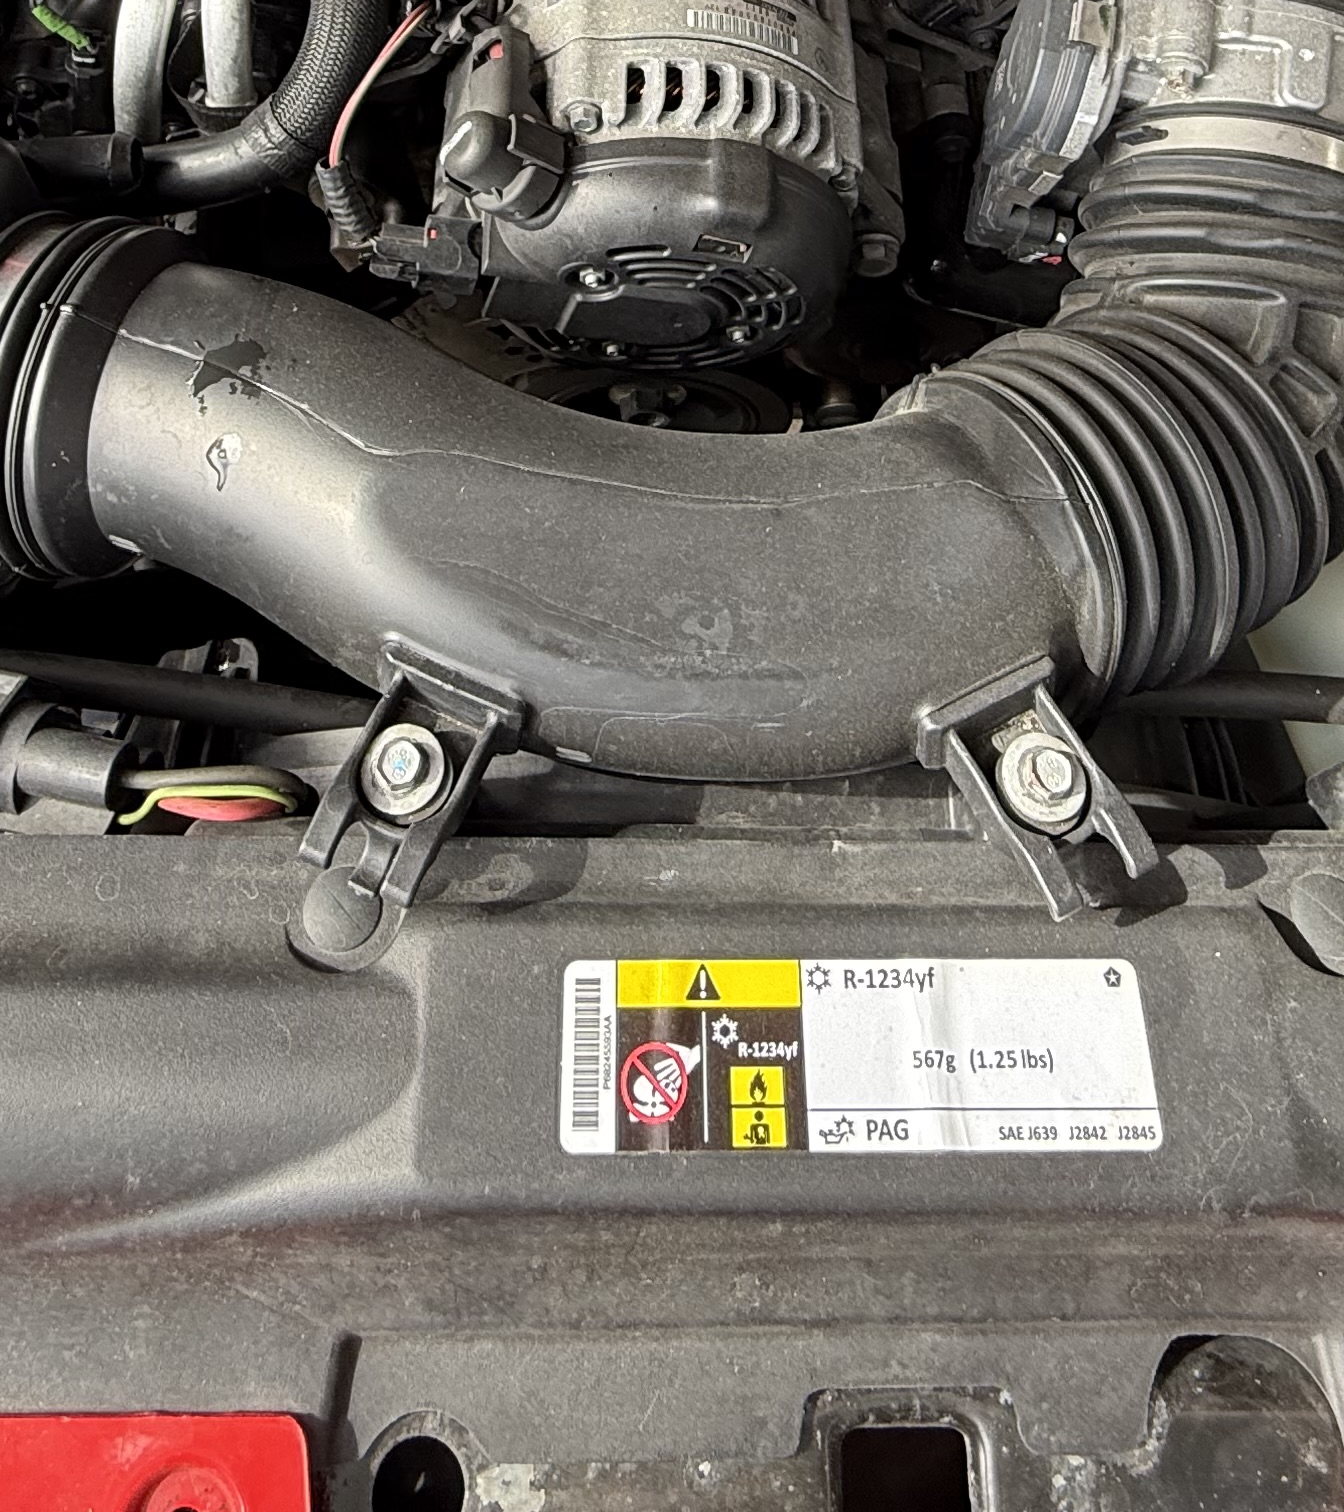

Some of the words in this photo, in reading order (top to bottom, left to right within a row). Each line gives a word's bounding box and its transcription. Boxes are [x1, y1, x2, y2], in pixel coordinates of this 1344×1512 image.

[843, 966, 936, 993] R-1234yf
[737, 1040, 799, 1062] R-1234yf
[912, 1049, 957, 1073] 567g
[969, 1048, 1018, 1074] (1.25
[1021, 1048, 1055, 1074] lbs)
[866, 1119, 910, 1140] PAG
[998, 1126, 1025, 1141] SAE
[1027, 1126, 1058, 1140] J639
[1069, 1126, 1108, 1141] J2842
[1118, 1125, 1157, 1141] J2845
